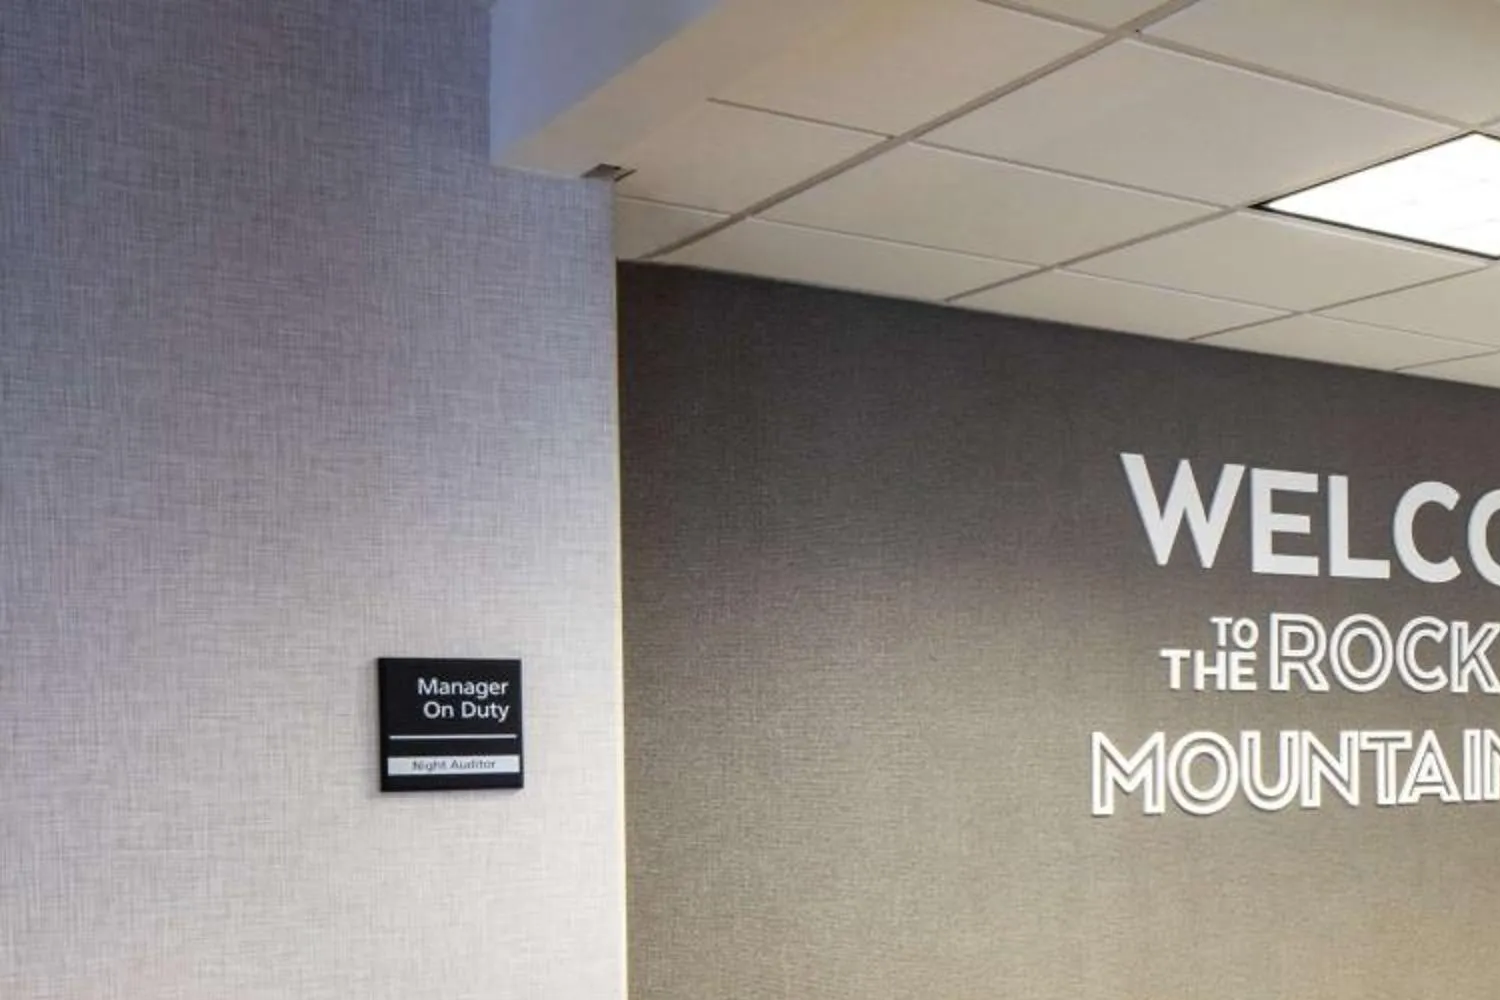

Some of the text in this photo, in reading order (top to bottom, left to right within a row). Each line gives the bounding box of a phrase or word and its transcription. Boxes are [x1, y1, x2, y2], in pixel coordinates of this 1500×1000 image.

[1211, 616, 1259, 650] TO
[1160, 649, 1258, 691] THE
[417, 677, 509, 699] Manager
[423, 701, 510, 722] On Duty
[412, 758, 496, 771] Night Auditor
